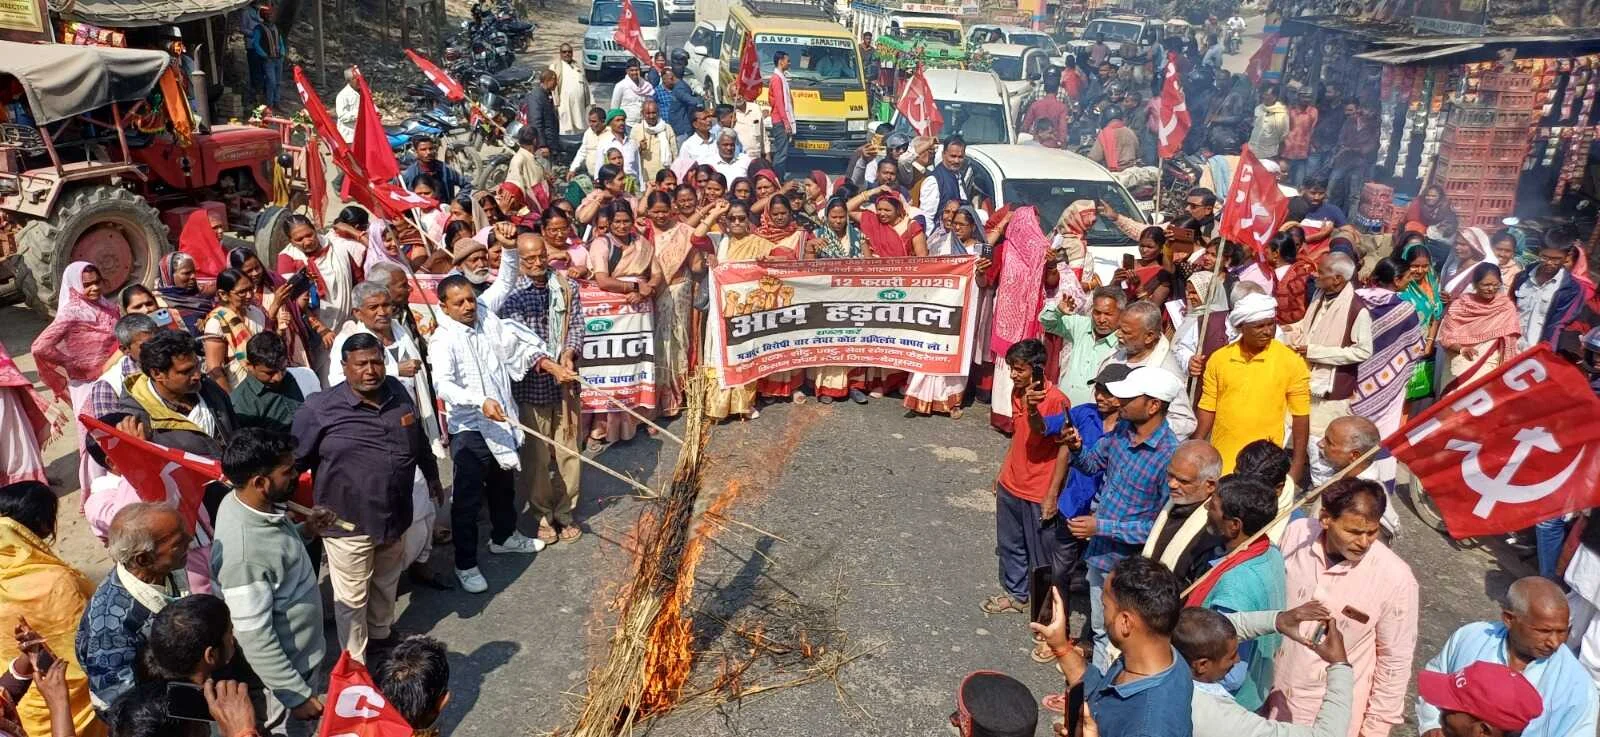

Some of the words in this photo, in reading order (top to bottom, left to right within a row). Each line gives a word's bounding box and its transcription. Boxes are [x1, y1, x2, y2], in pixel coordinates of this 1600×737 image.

[836, 279, 853, 287] 12
[859, 276, 905, 288] फरवरी
[911, 278, 954, 288] 2026
[884, 289, 900, 300] को
[591, 320, 608, 331] को
[732, 303, 810, 338] आम
[822, 303, 957, 328] हड़ताल
[762, 339, 790, 352] विरोधी
[926, 341, 941, 352] लो
[1405, 358, 1547, 447] CPI
